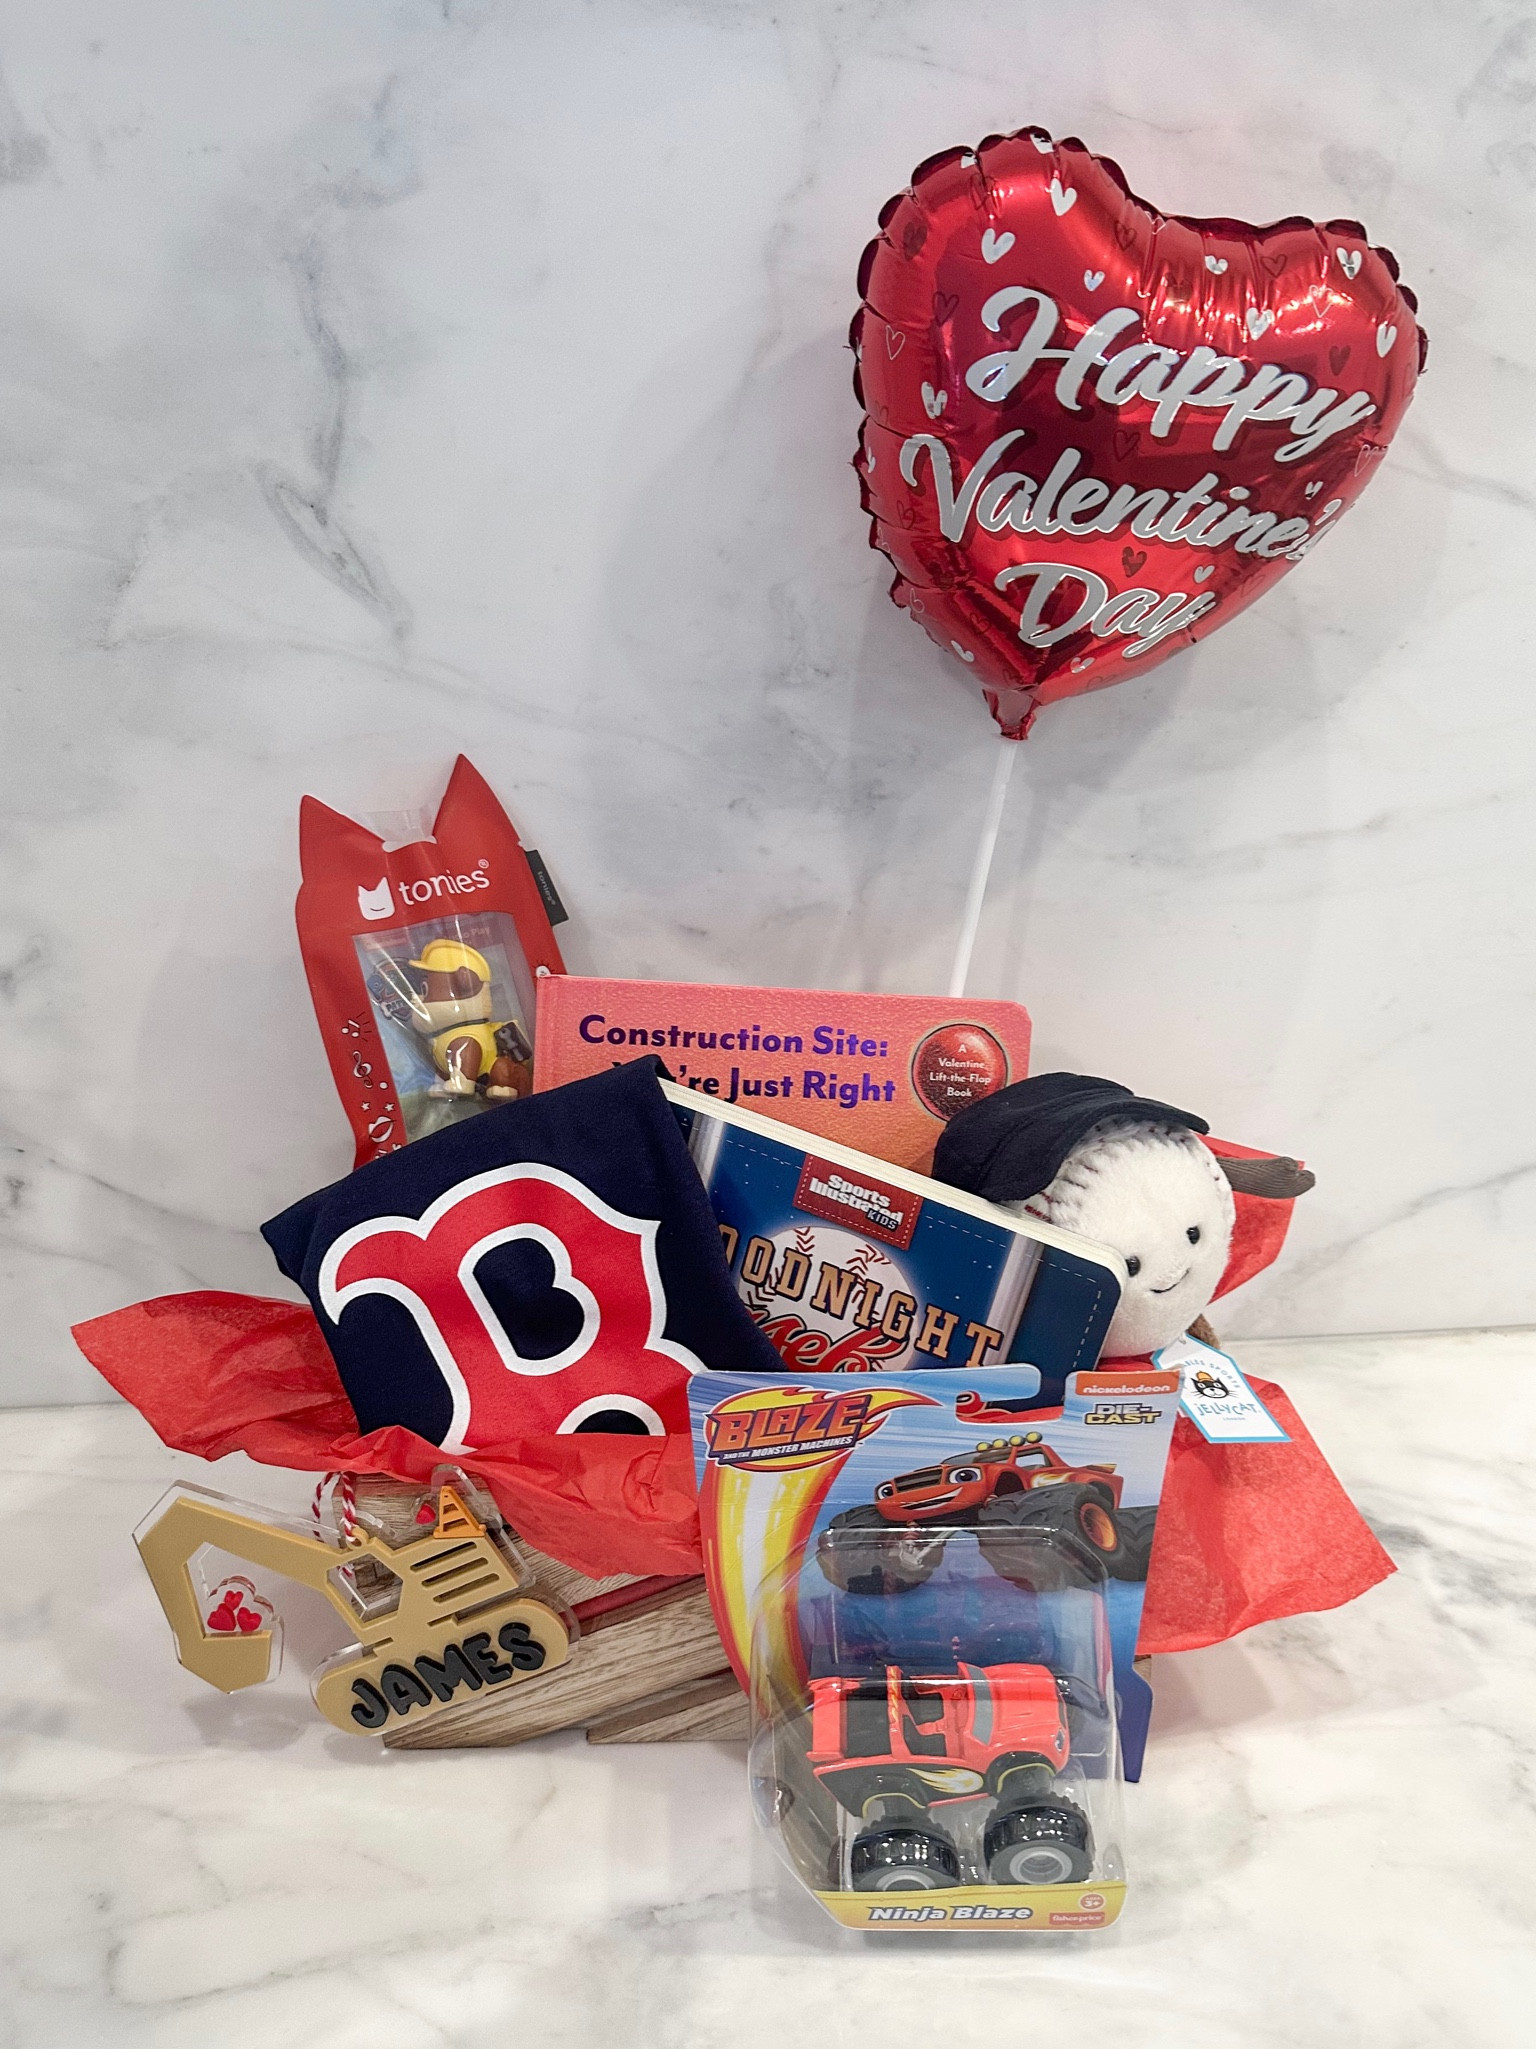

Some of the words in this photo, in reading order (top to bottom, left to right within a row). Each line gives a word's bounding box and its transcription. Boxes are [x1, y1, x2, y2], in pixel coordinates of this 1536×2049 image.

[965, 286, 1376, 462] Happy
[995, 562, 1217, 658] Day
[579, 1014, 802, 1053] Construction
[812, 1026, 889, 1058] Site:
[958, 1044, 967, 1053] A
[938, 1057, 986, 1069] Valentine
[723, 1067, 792, 1104] Just
[803, 1070, 897, 1109] Right
[929, 1072, 992, 1086] Lift-the-Flap
[946, 1086, 973, 1097] Book
[808, 1177, 905, 1226] Illustrated
[828, 1174, 892, 1208] Sports
[867, 1209, 898, 1230] KIDS
[1082, 1384, 1171, 1394] nickelodeon
[1086, 1411, 1161, 1425] CAST
[1096, 1403, 1154, 1415] DIE-
[708, 1395, 870, 1452] BLAZE
[751, 1443, 799, 1457] MONSTER
[800, 1436, 853, 1451] MACHINES
[350, 1622, 547, 1729] JAMES
[868, 1906, 946, 1922] Ninja
[951, 1905, 1033, 1921] Blaze
